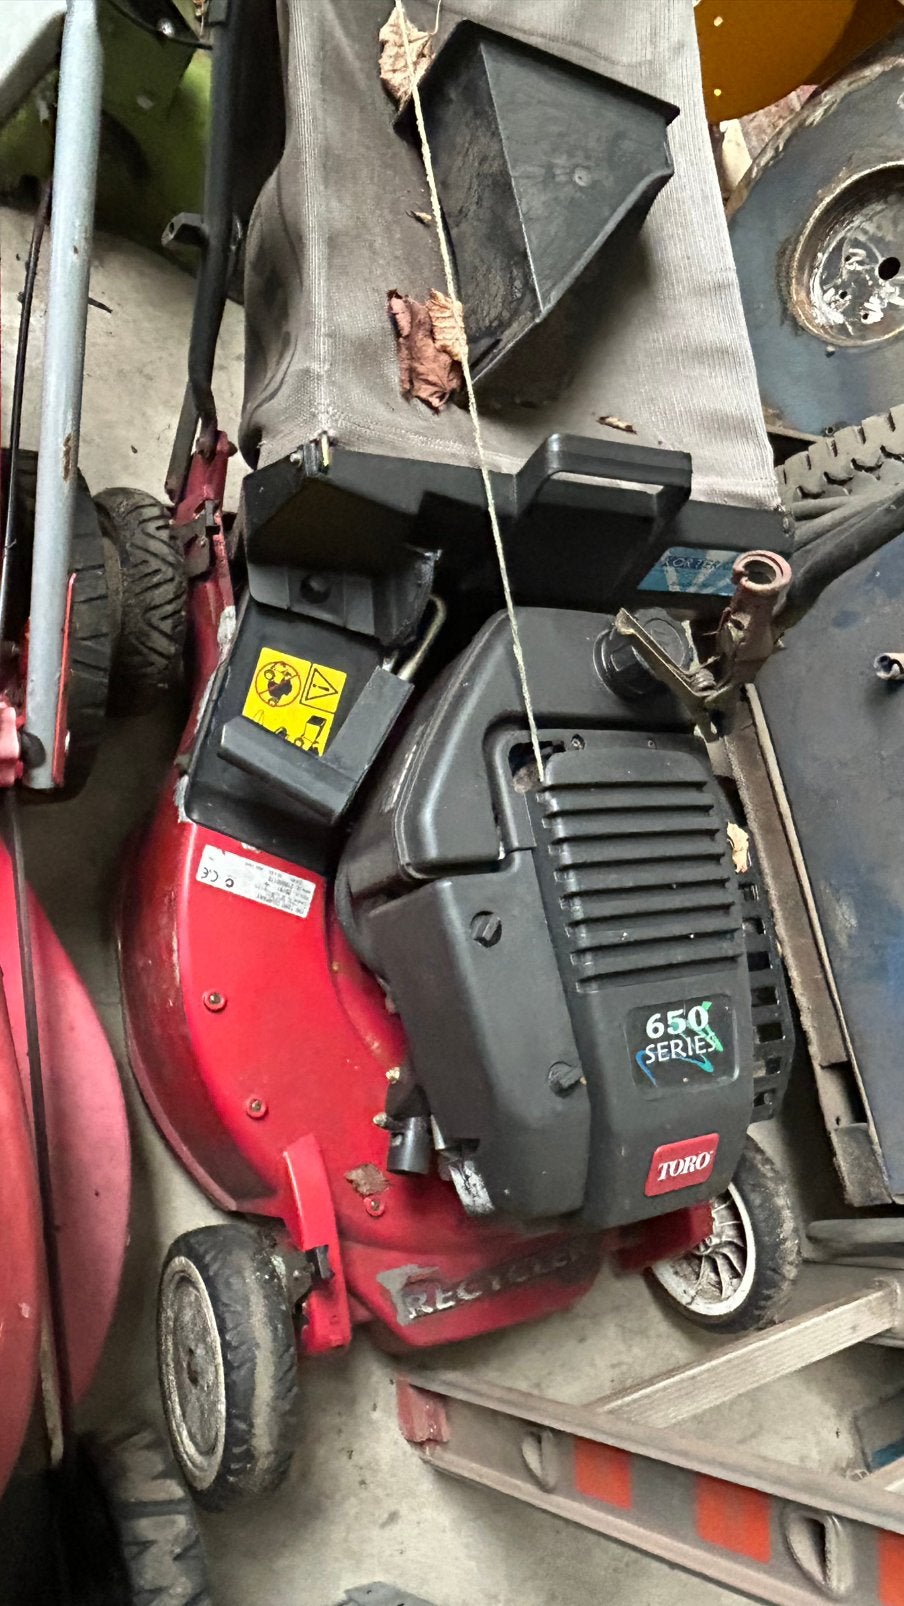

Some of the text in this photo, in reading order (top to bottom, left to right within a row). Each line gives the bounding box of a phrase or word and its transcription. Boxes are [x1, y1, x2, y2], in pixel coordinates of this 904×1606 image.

[646, 1005, 709, 1039] 650
[645, 1035, 717, 1065] SERIES
[657, 1151, 711, 1181] TORO
